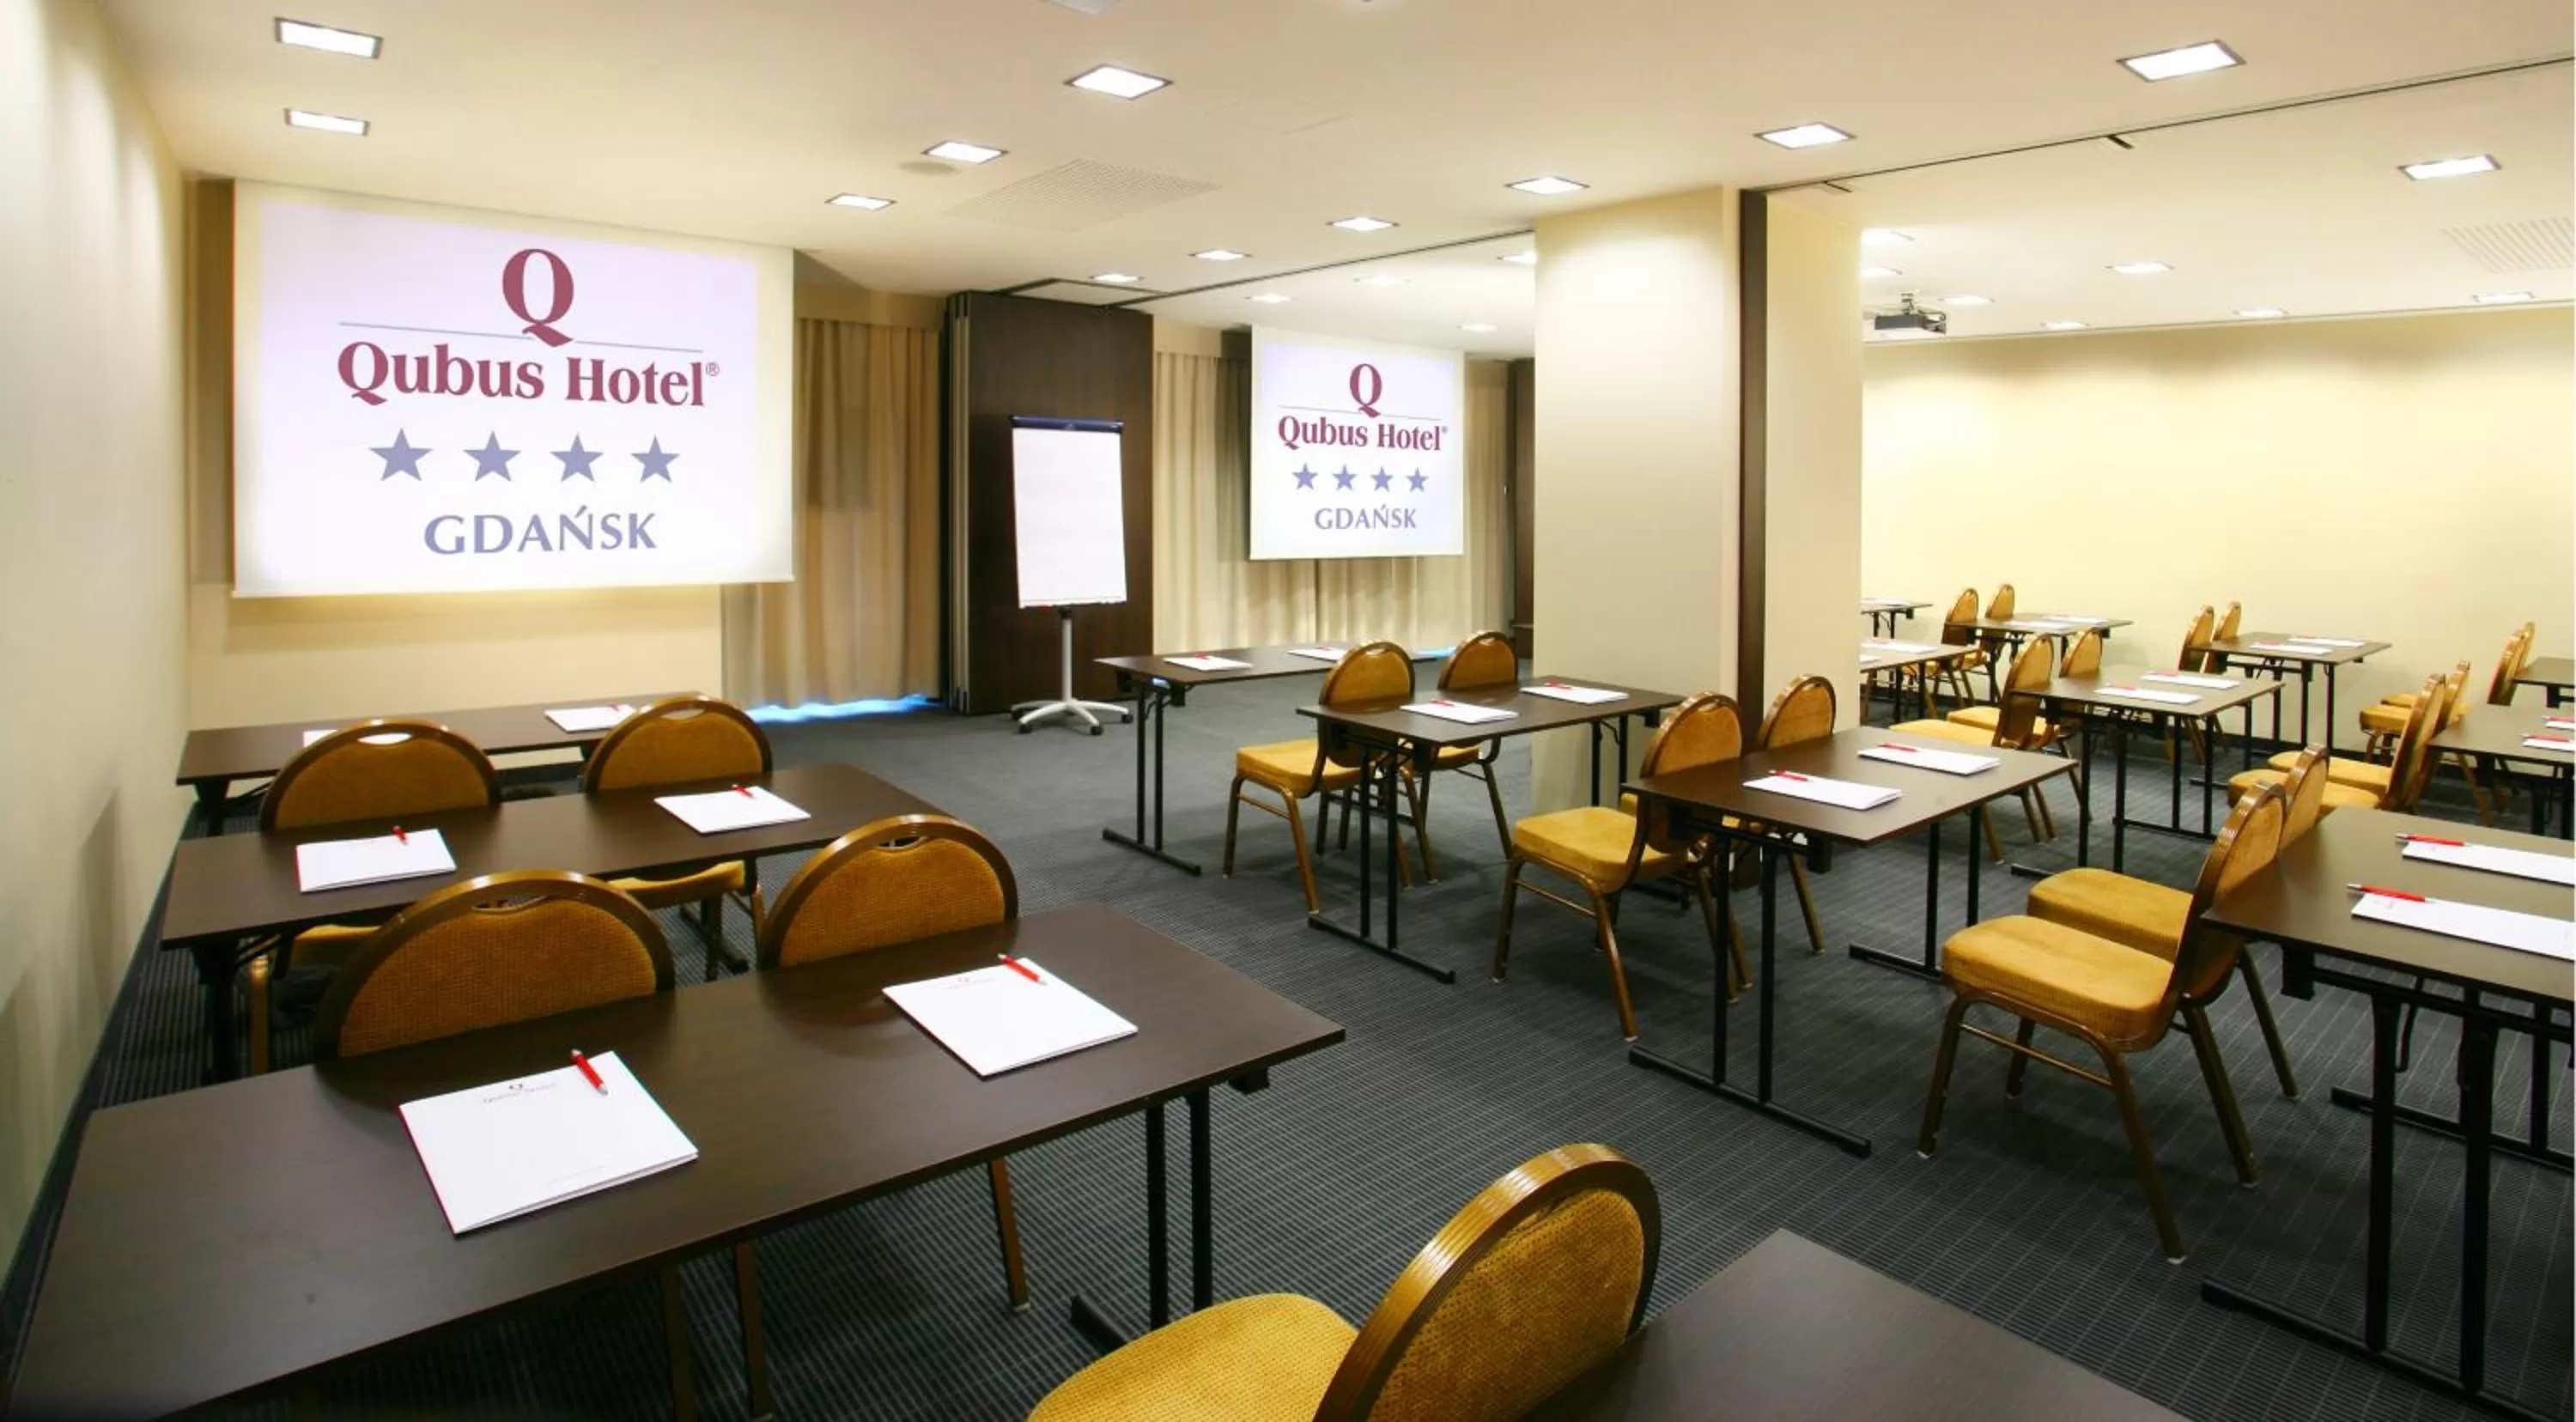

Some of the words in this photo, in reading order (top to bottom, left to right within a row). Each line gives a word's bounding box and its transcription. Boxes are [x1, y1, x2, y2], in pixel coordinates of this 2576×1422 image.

[502, 248, 574, 347] Q
[337, 342, 544, 406] Qubus
[1350, 363, 1382, 418] Q
[1278, 416, 1368, 451] Qubus
[423, 505, 658, 555] GDAŃSK
[1315, 504, 1417, 530] GDAŃSK
